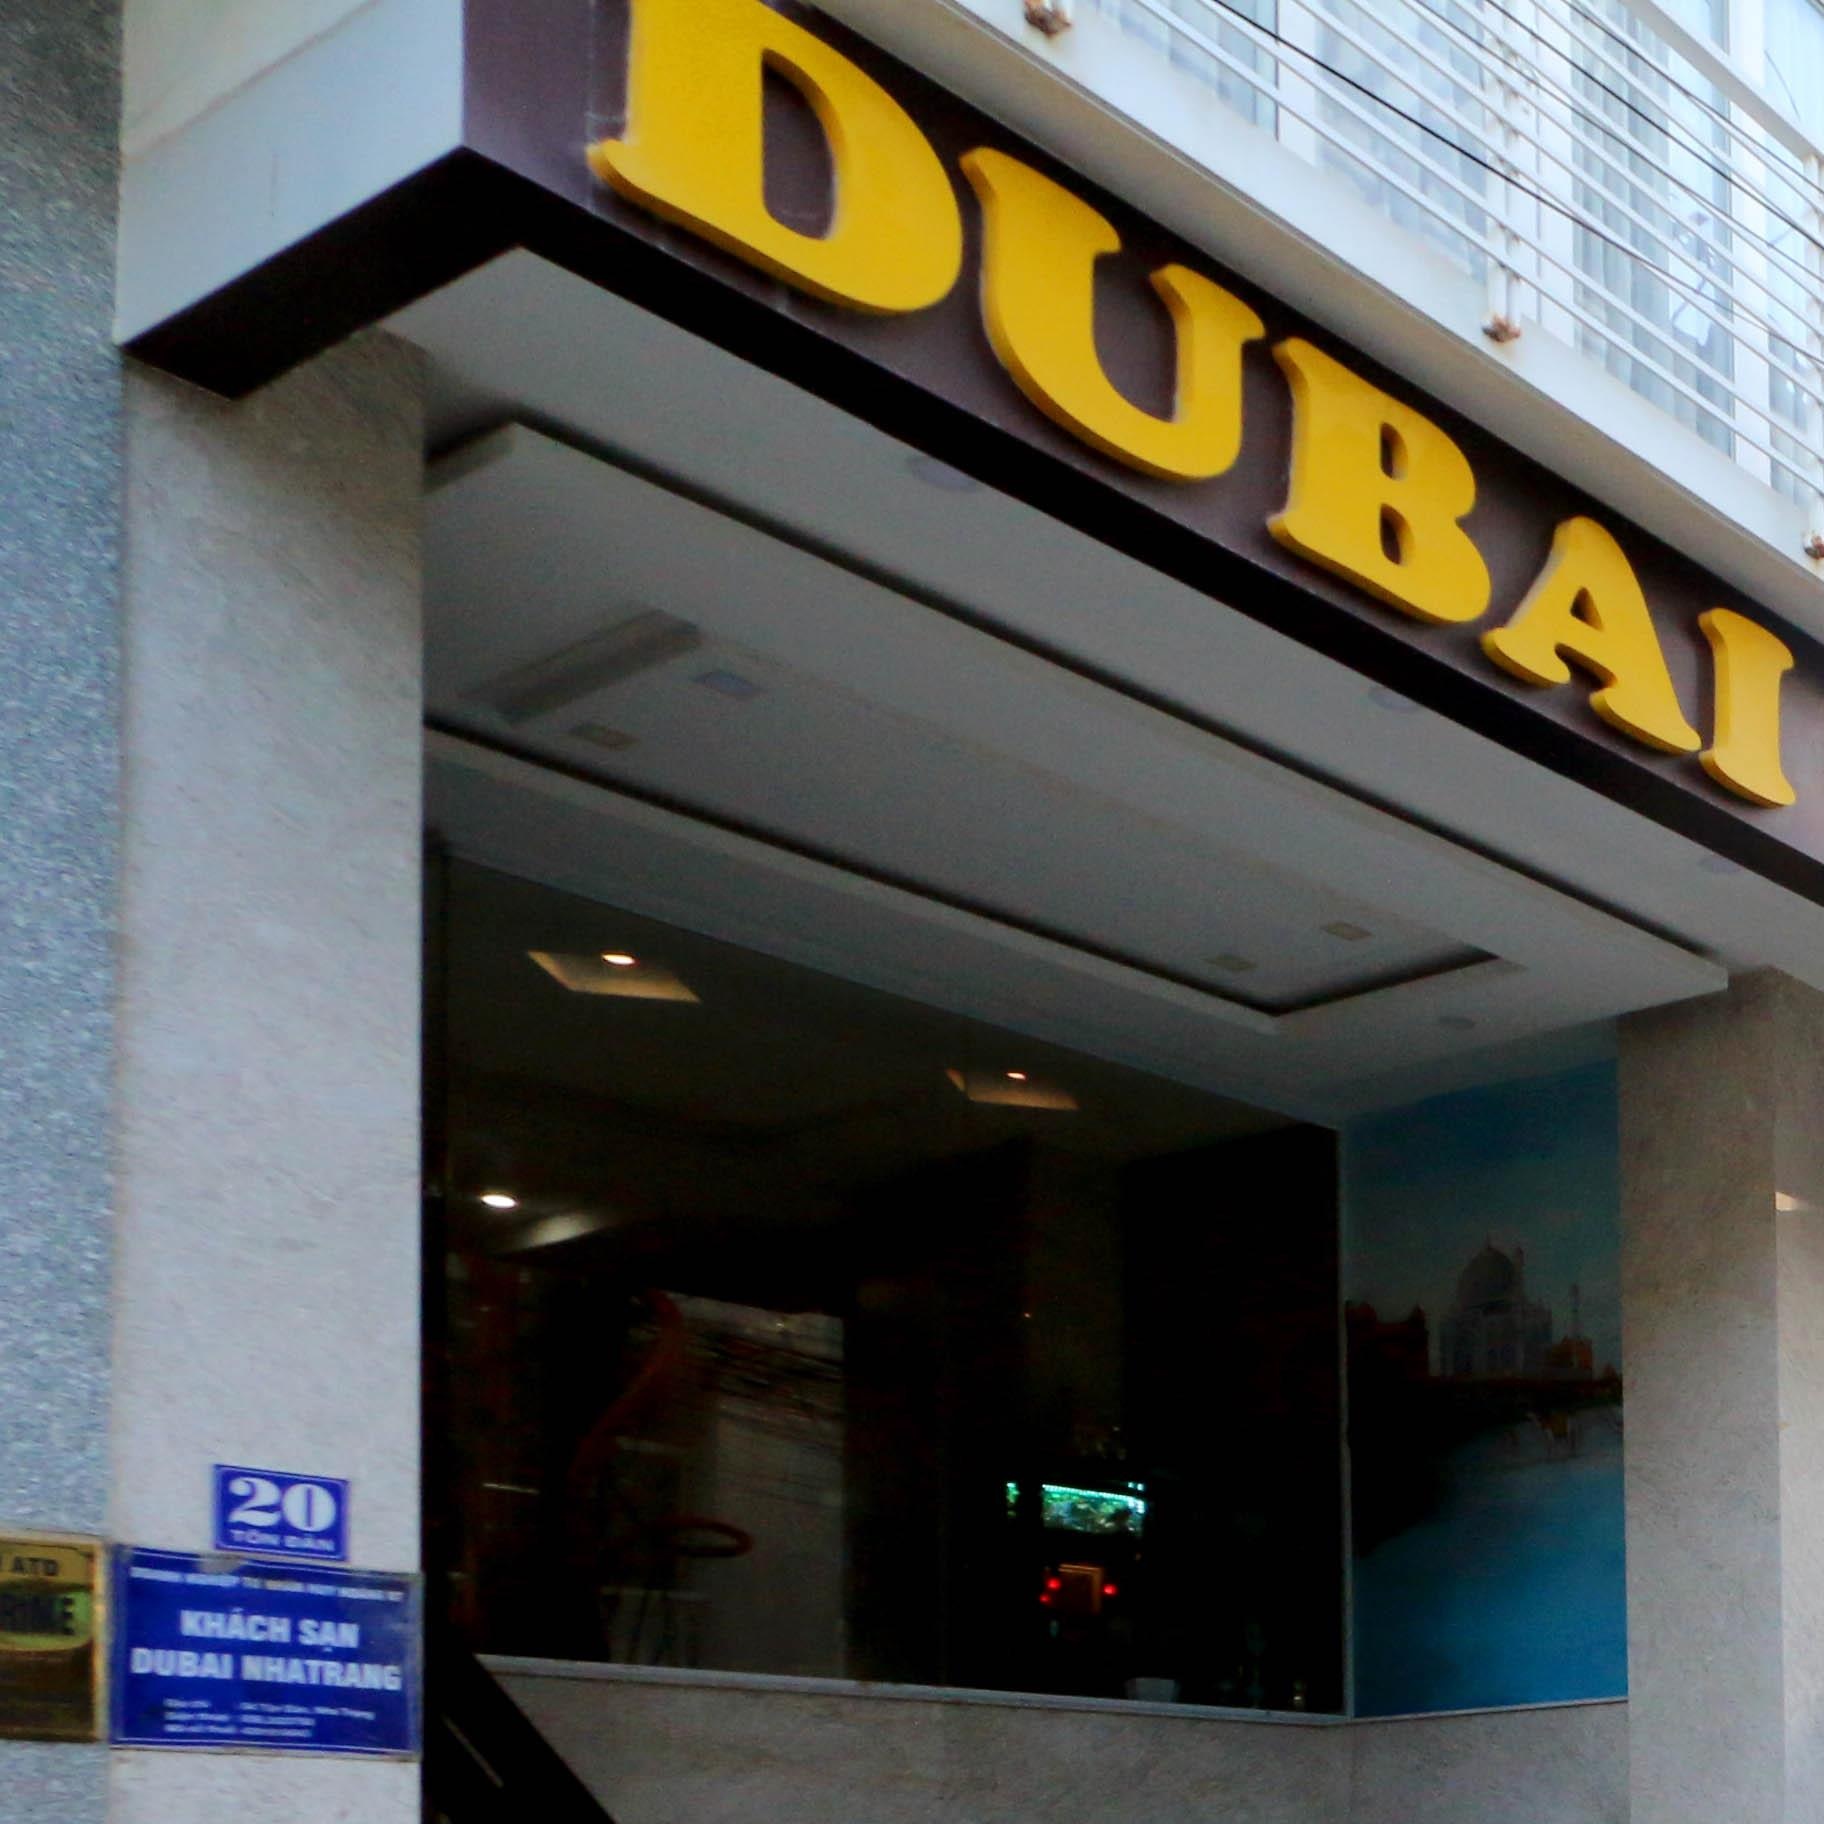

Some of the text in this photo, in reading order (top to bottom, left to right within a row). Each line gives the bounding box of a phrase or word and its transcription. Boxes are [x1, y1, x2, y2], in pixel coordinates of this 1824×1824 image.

[589, 0, 1795, 808] DUBAI
[228, 1476, 338, 1533] 20
[179, 1606, 360, 1653] KHÁCH SẠN
[130, 1647, 402, 1691] DUBAI NHATRANG
